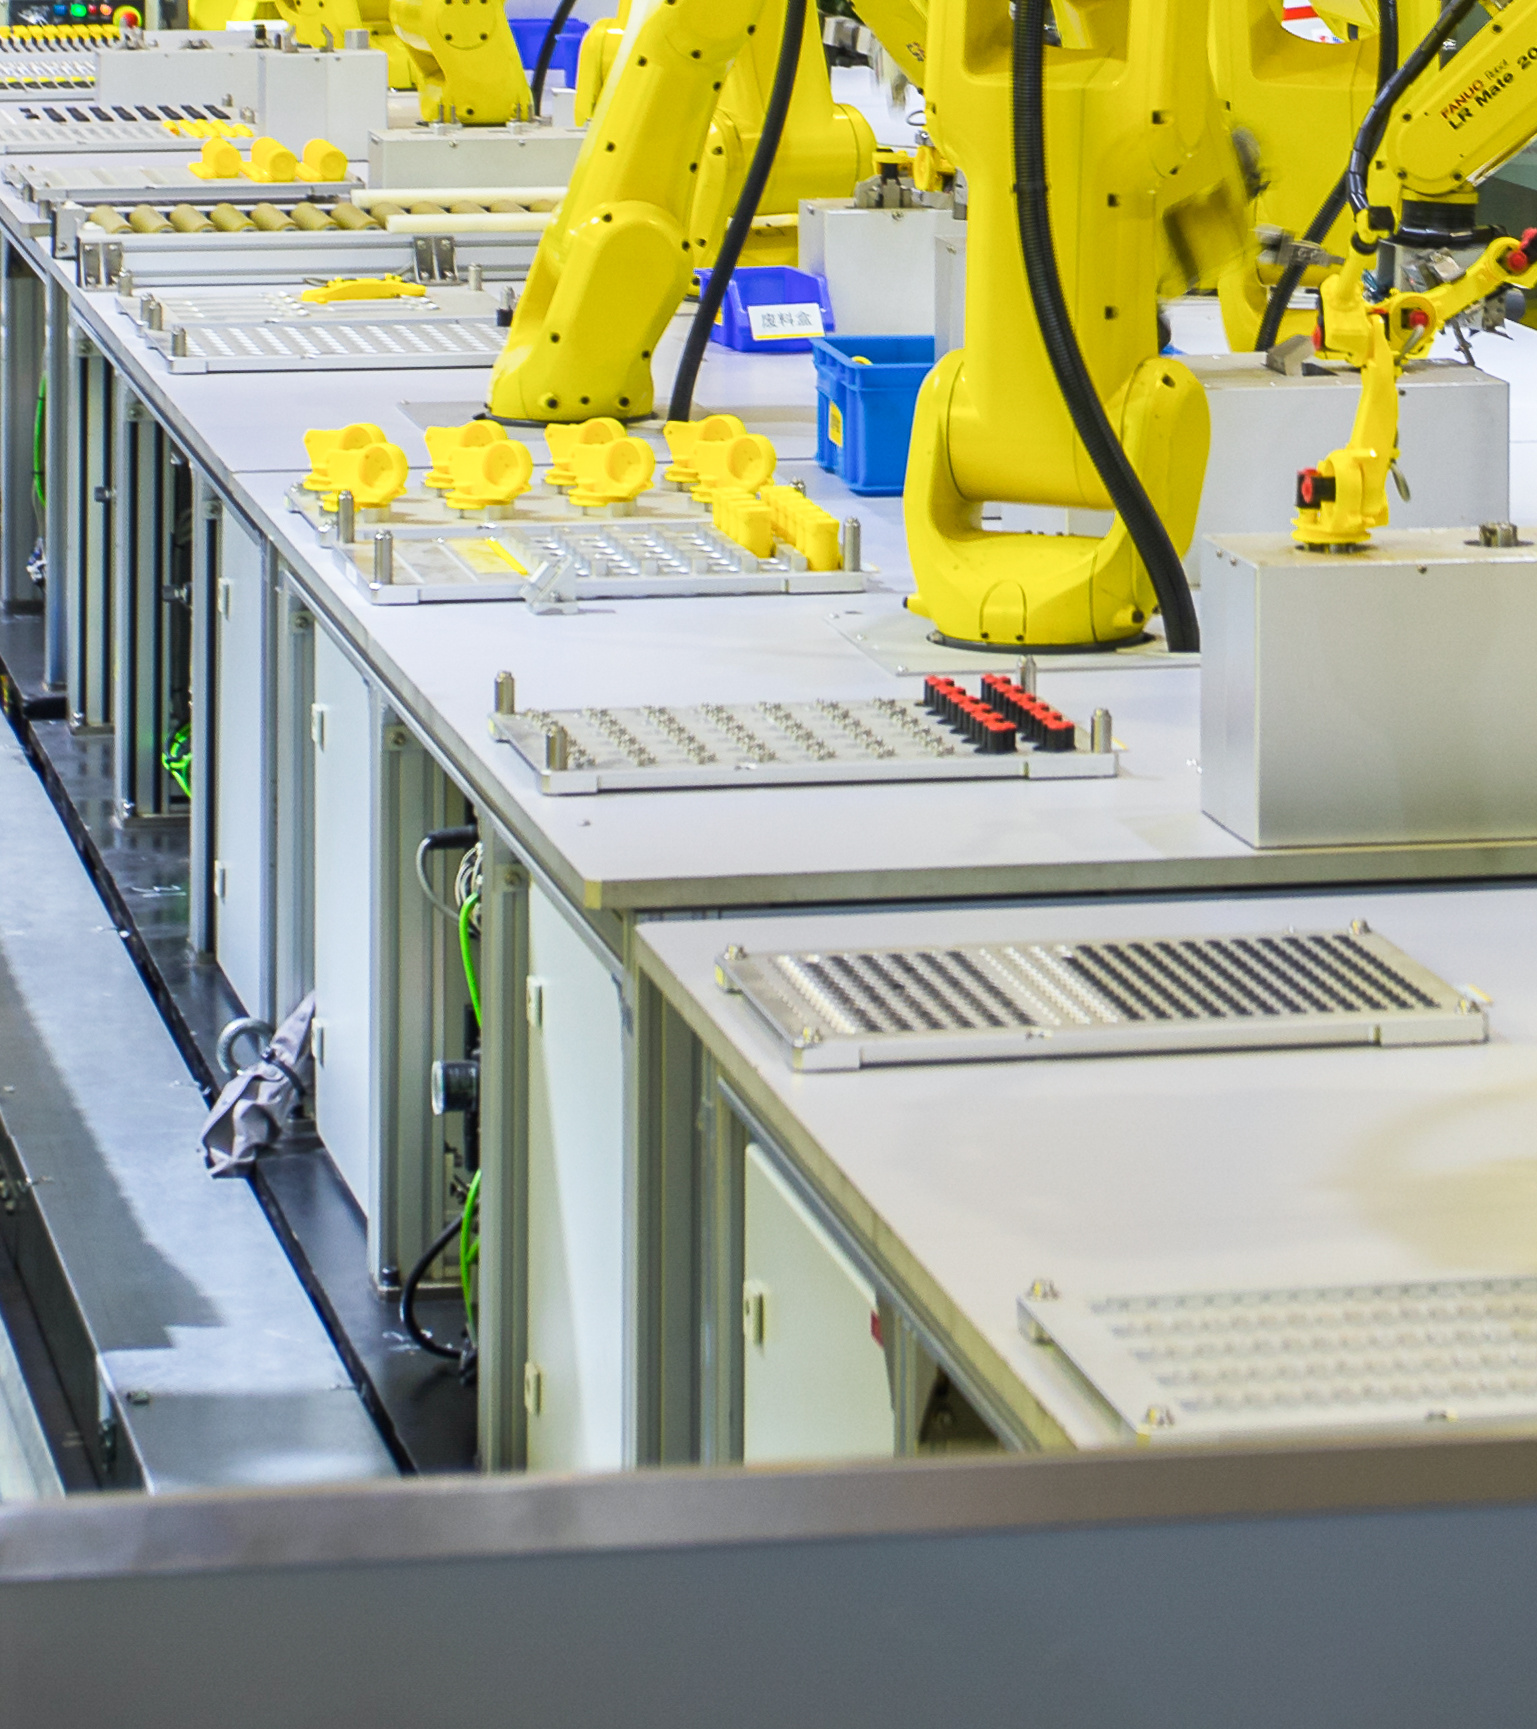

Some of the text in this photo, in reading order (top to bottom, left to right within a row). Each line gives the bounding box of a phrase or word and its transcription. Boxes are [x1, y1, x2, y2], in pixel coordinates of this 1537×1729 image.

[1440, 78, 1486, 121] FANUC
[1446, 105, 1475, 132] LR
[1474, 69, 1515, 110] Mate
